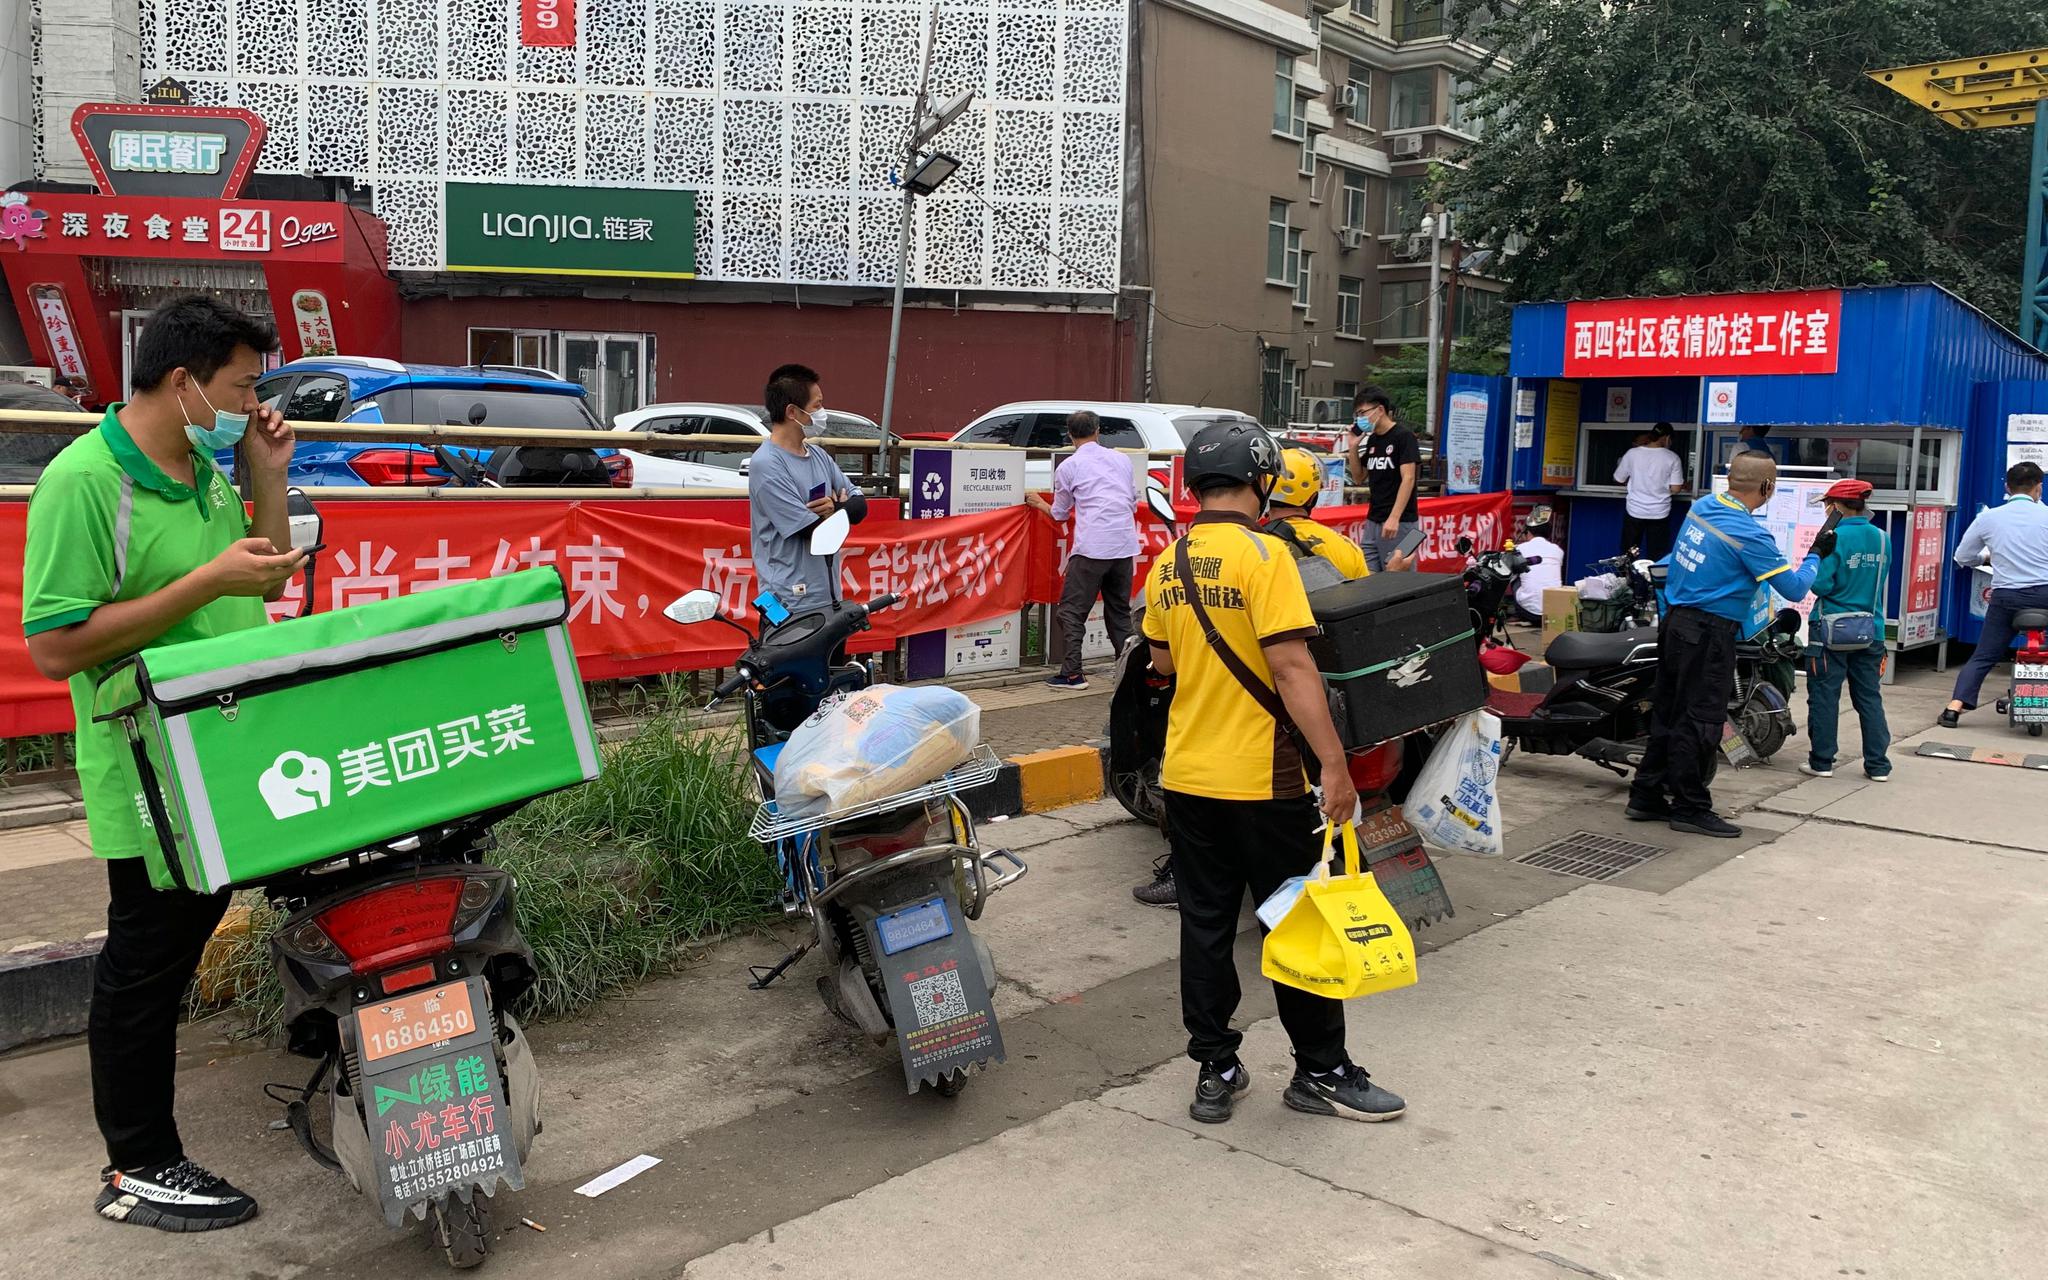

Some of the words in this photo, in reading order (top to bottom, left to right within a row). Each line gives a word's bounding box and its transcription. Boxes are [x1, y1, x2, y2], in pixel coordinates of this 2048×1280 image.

[110, 131, 226, 172] 便民餐厅
[61, 211, 210, 242] 深夜食堂
[223, 211, 268, 248] 24
[224, 240, 256, 248] 小时营业
[1573, 309, 1829, 359] 西四社区疫情防控工作室
[969, 468, 1007, 481] 可回收物
[1366, 456, 1395, 470] NASA
[963, 484, 995, 492] RECYCLABLE
[995, 484, 1013, 492] WASTE
[1159, 556, 1223, 585] 美跑腿
[337, 703, 535, 797] 美团买菜
[390, 998, 442, 1024] 京临
[371, 1009, 470, 1054] 1686450
[420, 1055, 490, 1106] 绿能
[384, 1095, 495, 1160] 小尤车行
[394, 1153, 504, 1200] 电话:13552804924
